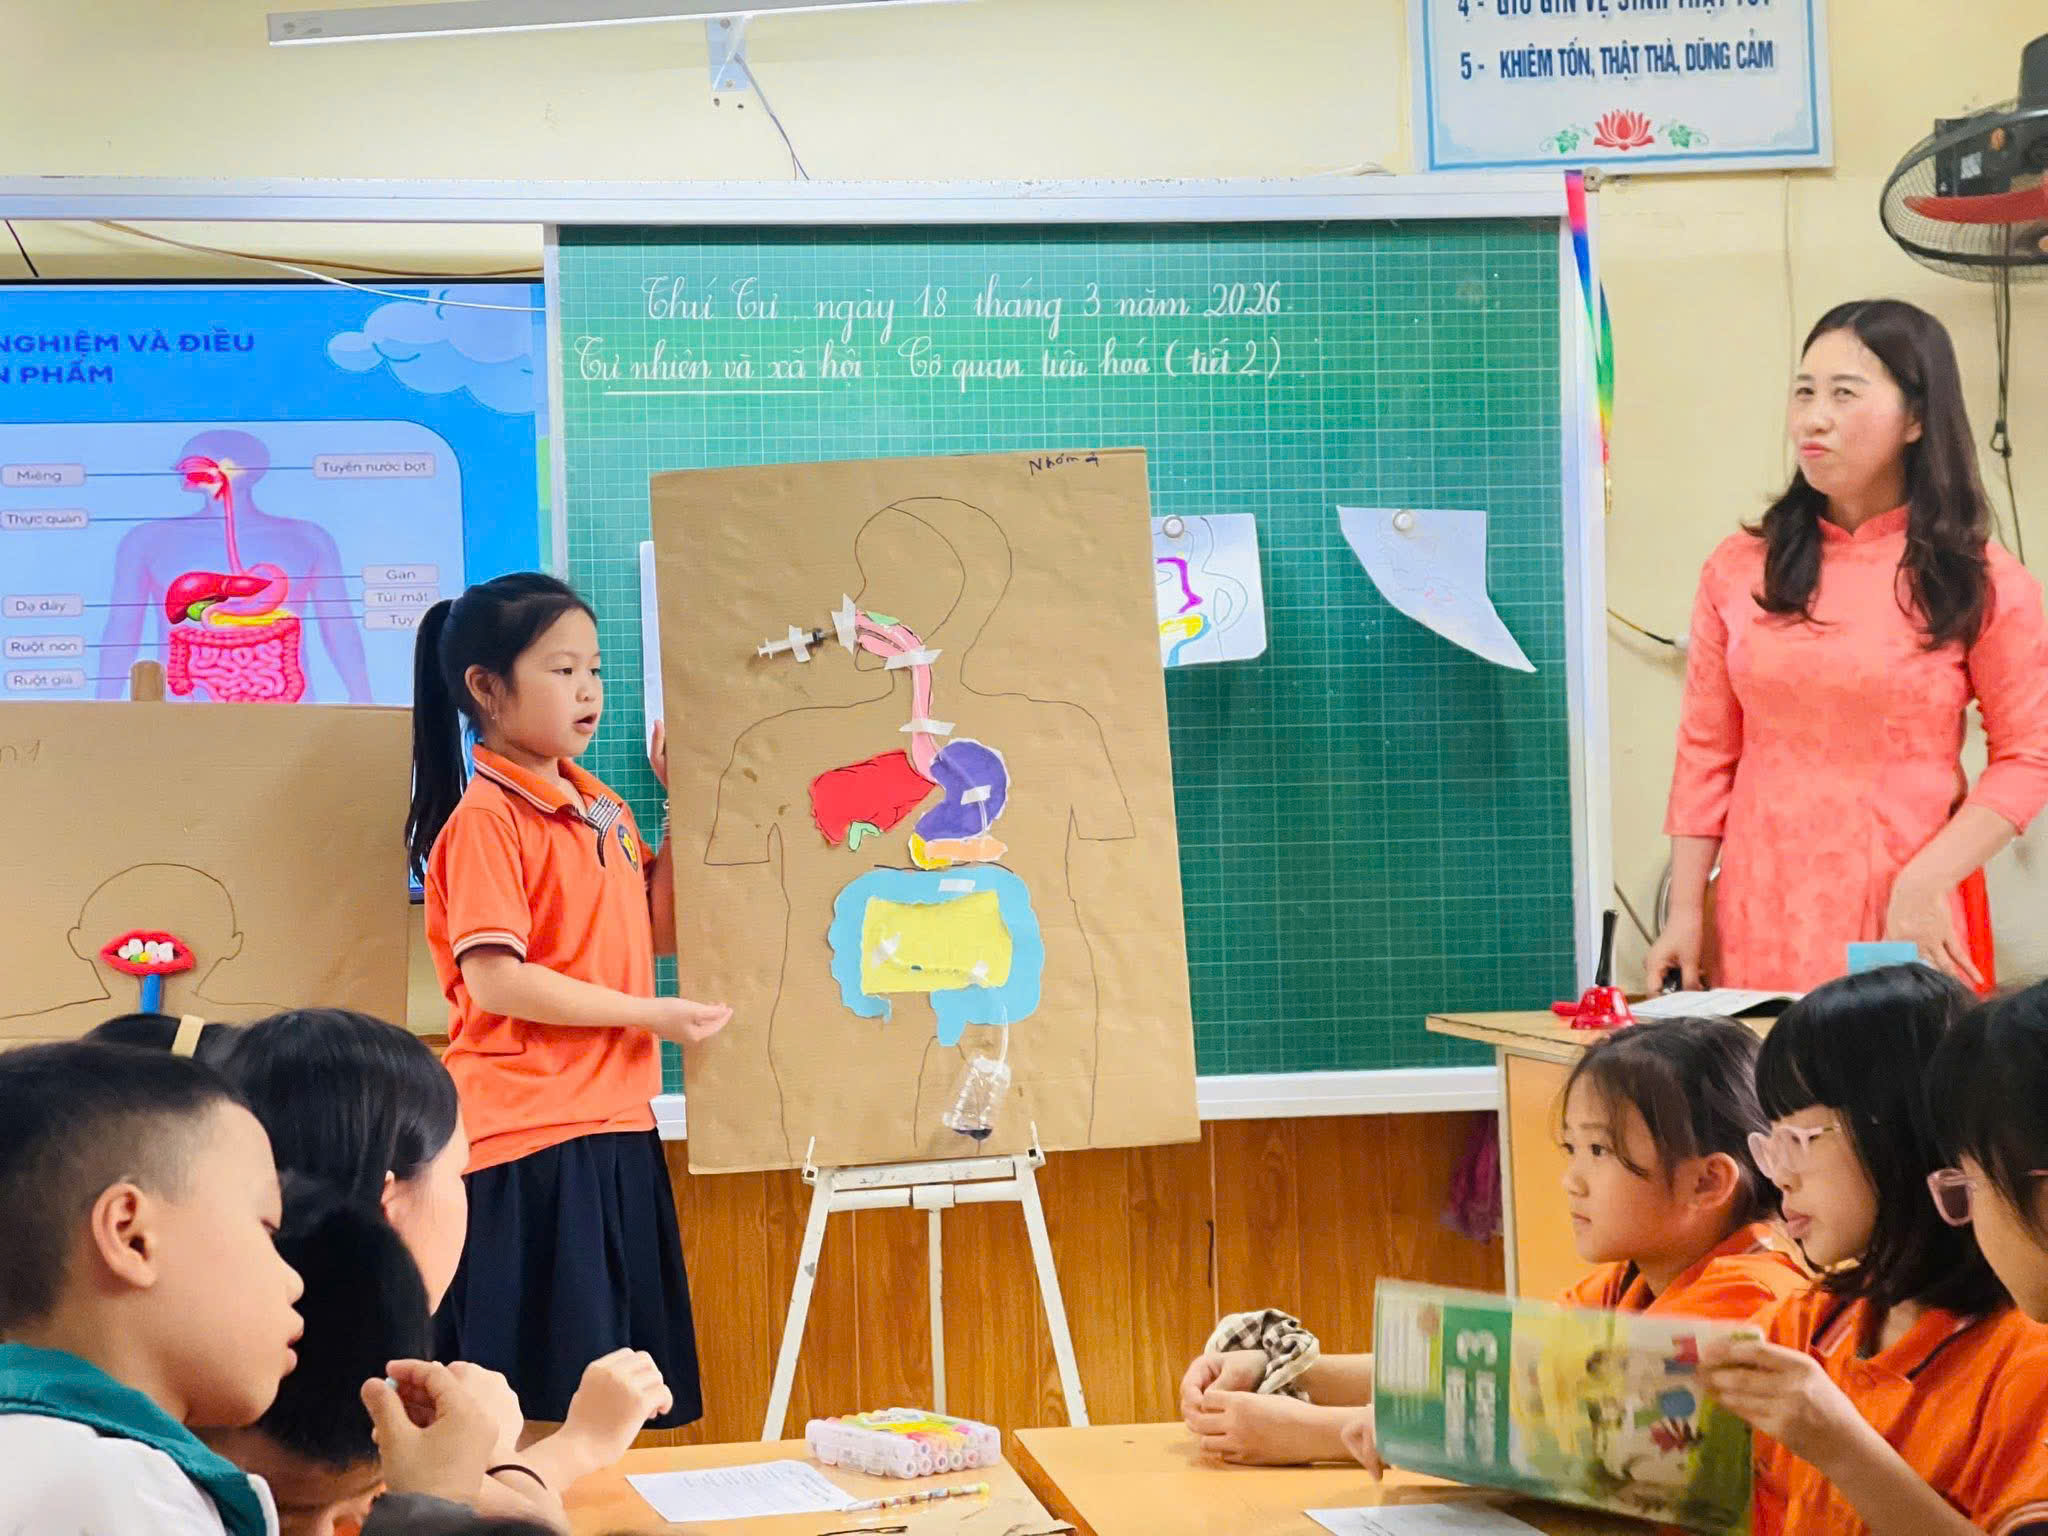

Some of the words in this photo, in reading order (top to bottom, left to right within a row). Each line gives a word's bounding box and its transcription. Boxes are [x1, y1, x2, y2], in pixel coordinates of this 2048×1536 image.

[1460, 52, 1472, 80] 5
[1499, 43, 1554, 79] KHIÊM
[1558, 37, 1595, 78] TỐN,
[1600, 40, 1640, 81] THẬT
[1644, 37, 1681, 74] THÀ,
[1685, 37, 1731, 71] DŨNG
[1735, 27, 1774, 69] CẢM
[813, 288, 894, 344] ngày
[913, 283, 947, 317] 18
[972, 272, 1062, 340] tháng
[1083, 282, 1101, 317] 3
[1113, 287, 1190, 317] năm
[127, 328, 169, 353] VÀ
[177, 326, 255, 353] ĐIỀU
[630, 339, 712, 380] nhiên
[768, 347, 807, 380] xã
[952, 358, 1025, 393] quan
[1042, 348, 1089, 377] tiêu
[1098, 335, 1150, 377] hoá
[386, 569, 416, 581] Gan
